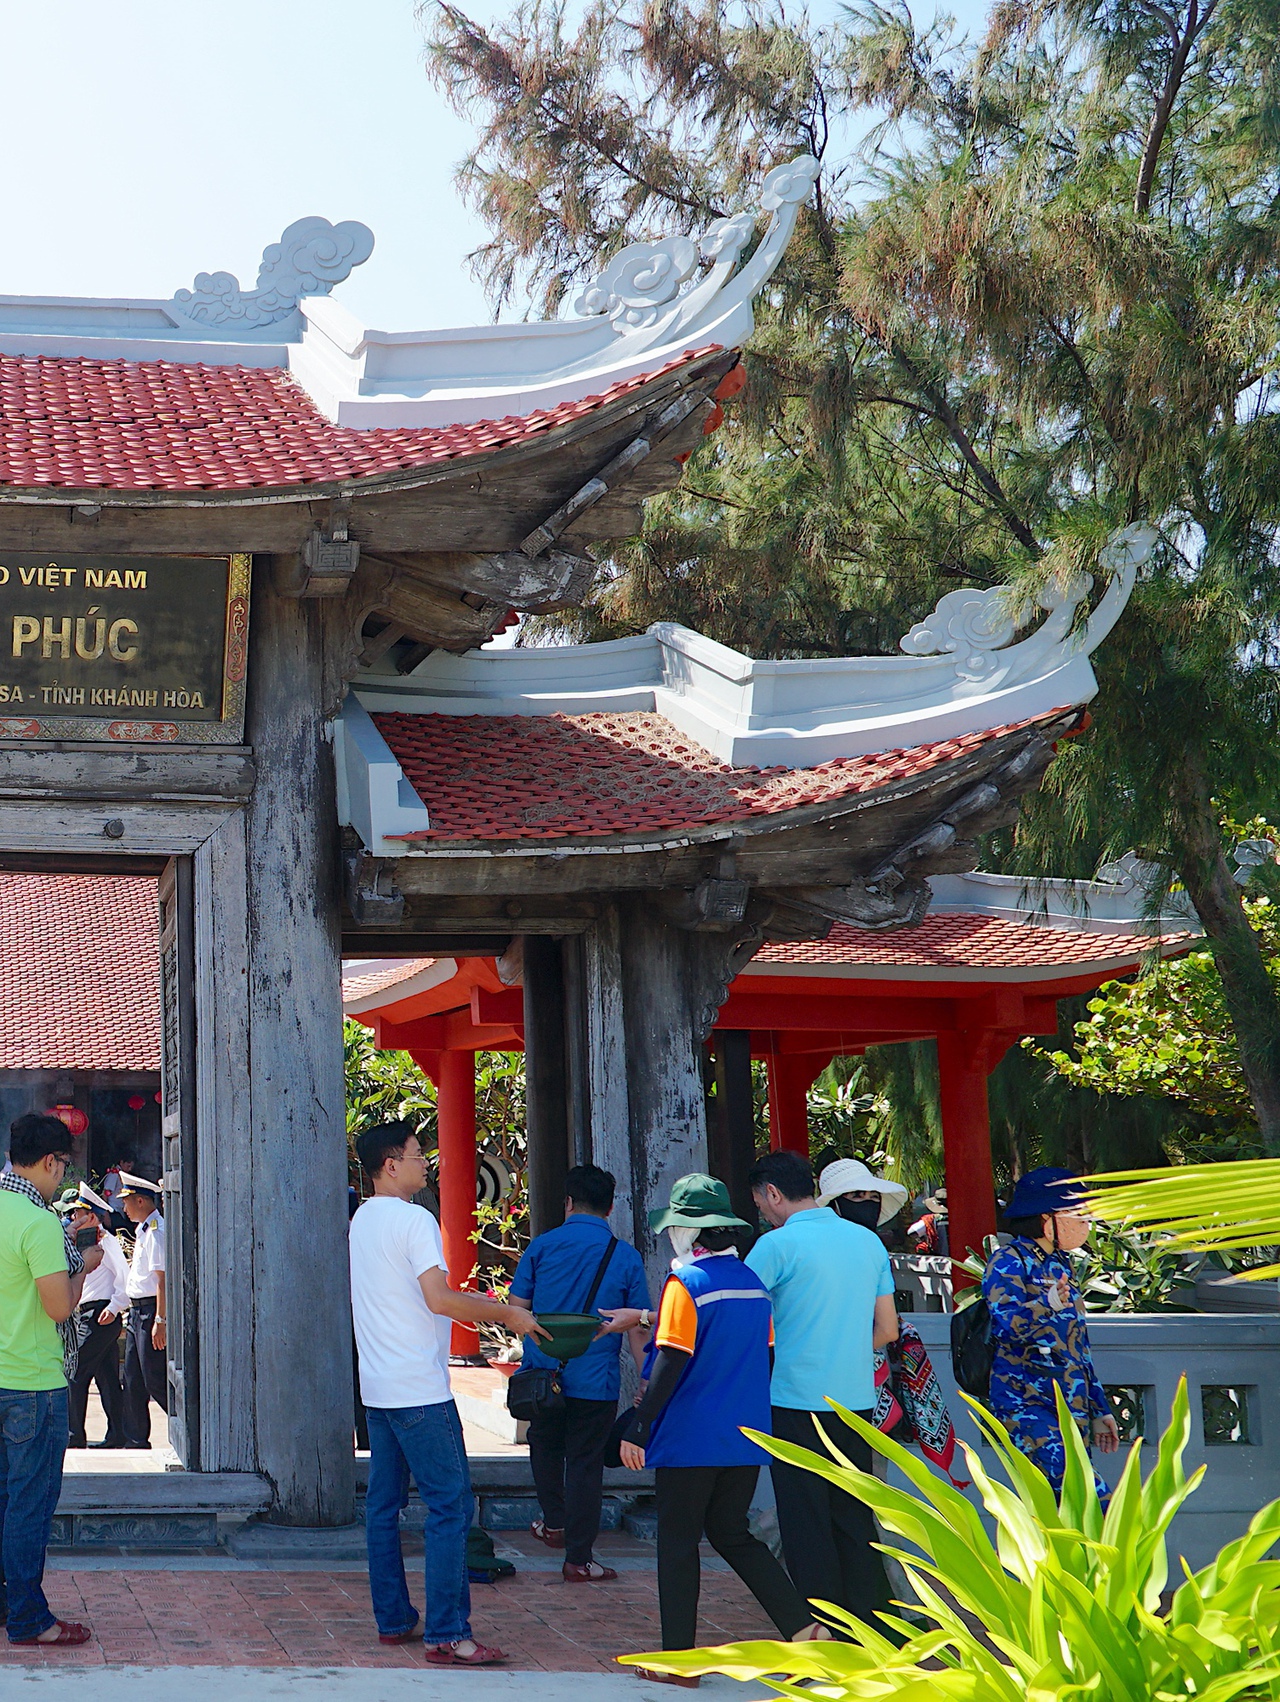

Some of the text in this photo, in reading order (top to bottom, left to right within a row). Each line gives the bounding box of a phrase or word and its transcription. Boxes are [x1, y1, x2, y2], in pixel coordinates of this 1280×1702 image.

[19, 563, 77, 592] VIỆT
[85, 569, 147, 589] NAM
[12, 606, 139, 661] PHÚC
[41, 680, 85, 705] TỈNH
[91, 685, 158, 707] KHÁNH
[164, 686, 205, 709] HÒA
